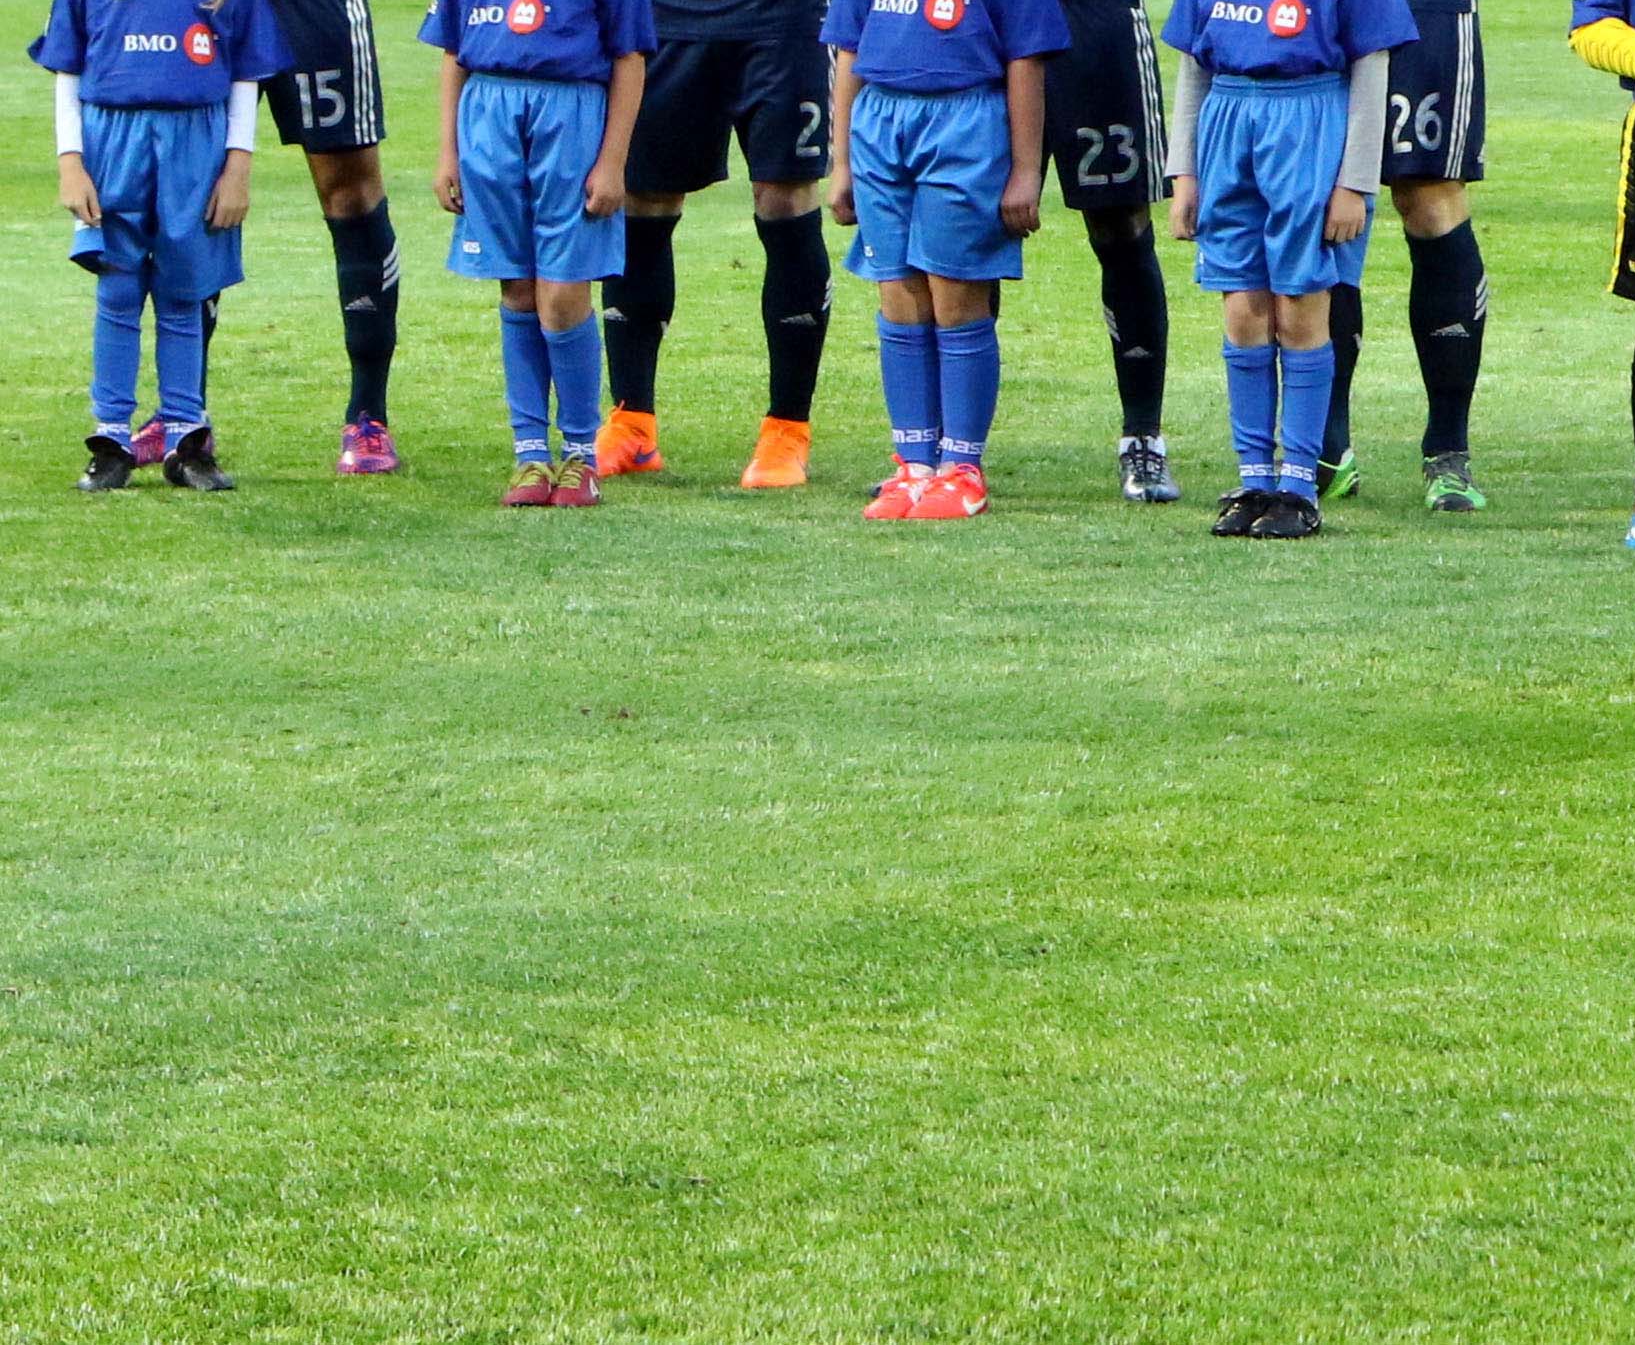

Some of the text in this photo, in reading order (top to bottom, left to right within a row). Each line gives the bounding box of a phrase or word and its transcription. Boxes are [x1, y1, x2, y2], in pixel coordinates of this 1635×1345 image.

[1211, 1, 1263, 25] BMO
[123, 34, 178, 53] BMO
[294, 69, 346, 129] 15
[1390, 91, 1443, 154] 26
[1076, 123, 1140, 187] 23
[1280, 463, 1315, 482] ass
